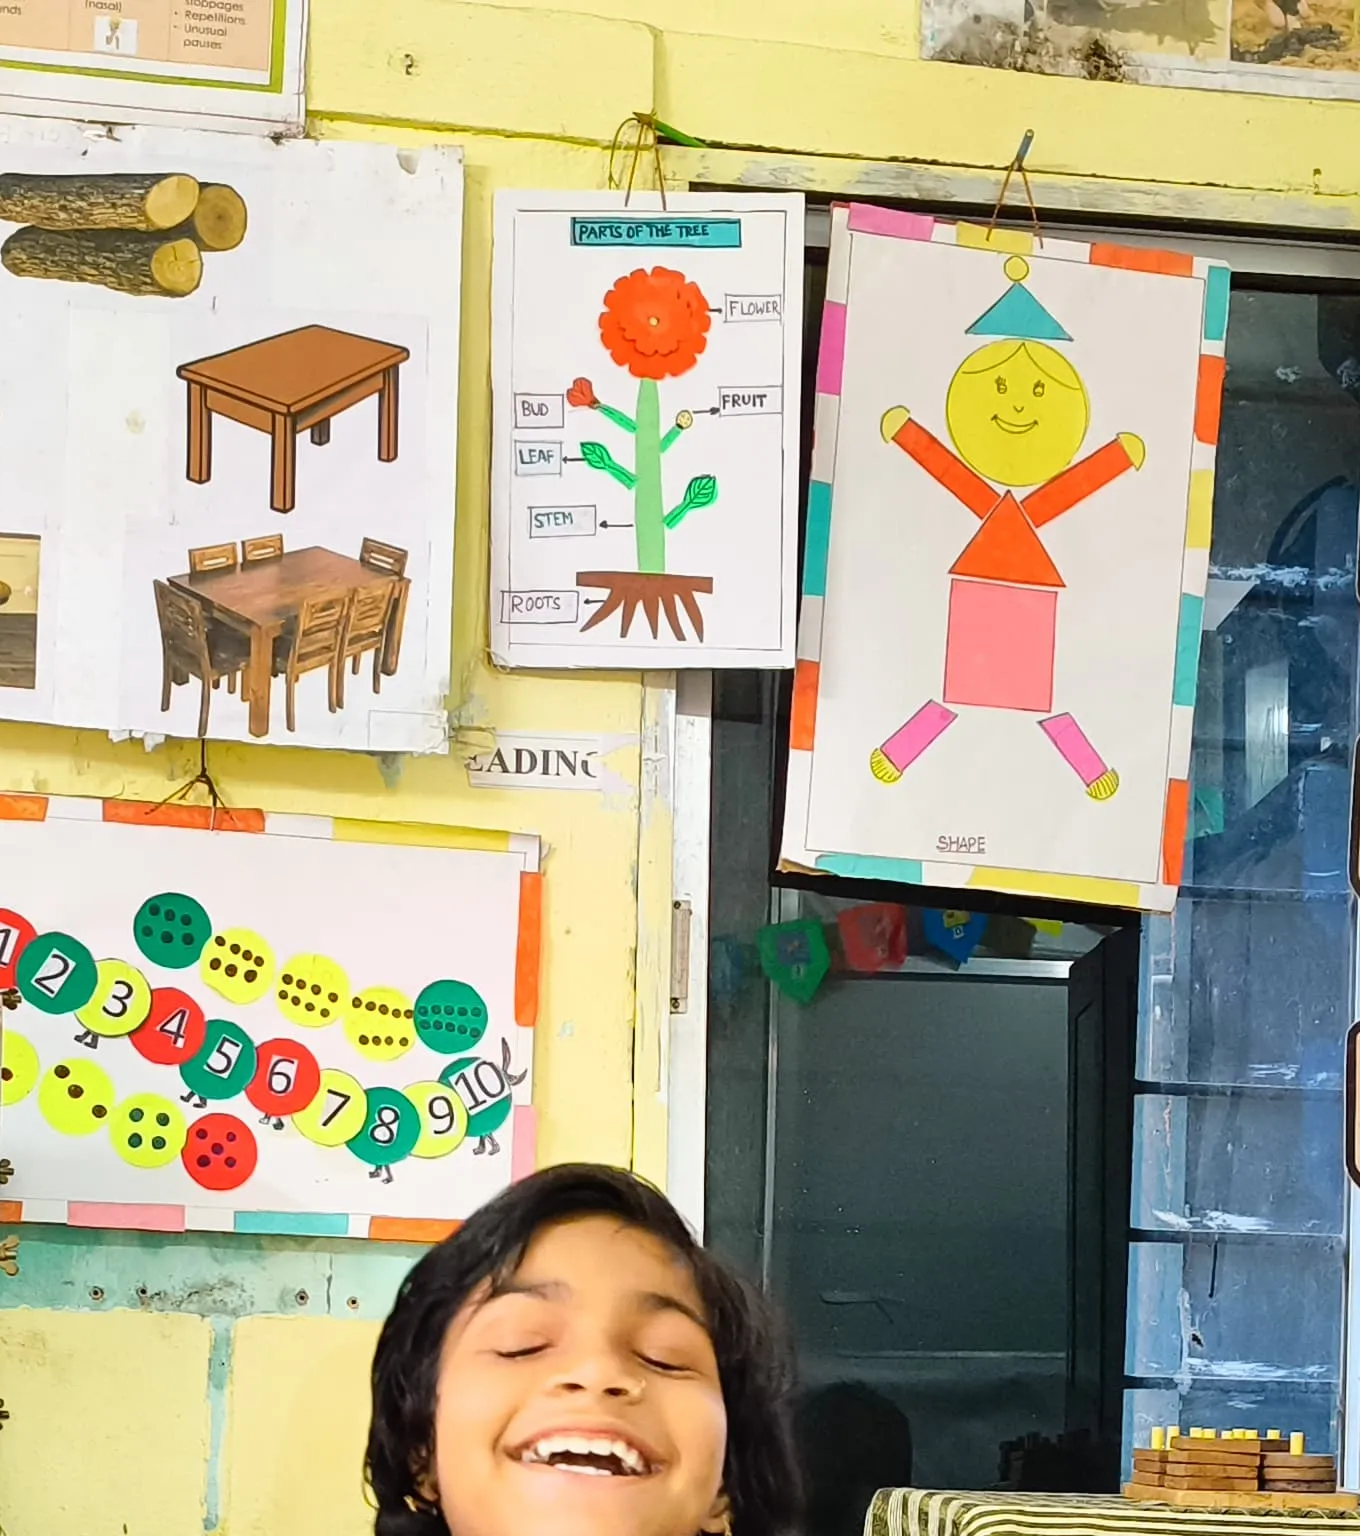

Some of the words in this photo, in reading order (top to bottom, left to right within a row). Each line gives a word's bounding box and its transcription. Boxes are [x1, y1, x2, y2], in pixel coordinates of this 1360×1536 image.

[183, 10, 247, 26] Repetitions
[183, 23, 228, 37] Unusual
[183, 37, 223, 51] pauses
[578, 224, 624, 242] PARTS
[626, 223, 644, 239] OF
[647, 222, 672, 239] THE
[675, 223, 710, 239] TREE
[728, 299, 780, 318] FLOWER
[520, 399, 550, 418] BUD
[720, 393, 768, 411] FRUIT
[518, 448, 556, 466] LEAF
[533, 511, 574, 529] STEM
[510, 595, 562, 614] ROOTS
[935, 835, 986, 854] SHAPE
[33, 953, 70, 995] 2
[101, 980, 134, 1018] 3
[159, 1008, 189, 1045] 4
[205, 1034, 242, 1075] 5
[267, 1058, 296, 1095] 6
[321, 1088, 352, 1127] 7
[369, 1105, 400, 1145] 8
[427, 1095, 456, 1135] 9
[453, 1060, 506, 1112] 10
